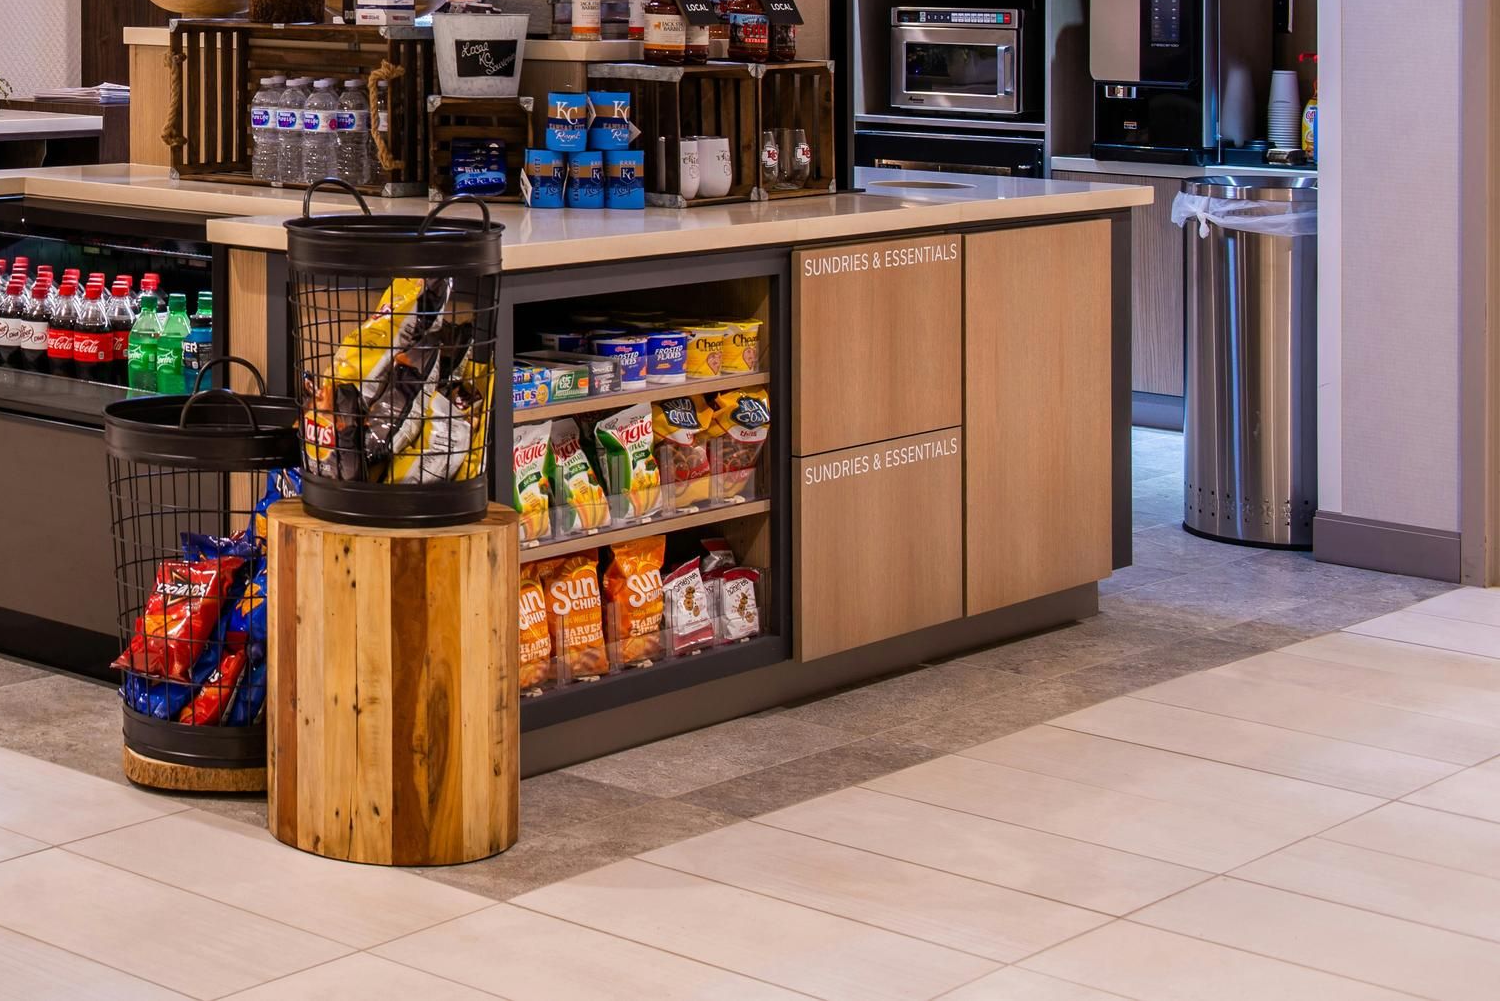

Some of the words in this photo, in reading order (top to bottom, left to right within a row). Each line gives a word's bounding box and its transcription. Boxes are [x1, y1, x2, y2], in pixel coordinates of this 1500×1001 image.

[686, 3, 709, 11] LOCAL
[771, 3, 794, 11] LOCAL
[461, 41, 489, 57] Local
[478, 52, 494, 67] KC
[555, 101, 579, 125] KC
[622, 169, 634, 180] KC
[804, 252, 869, 276] SUNDRIES
[872, 251, 881, 269] &
[885, 243, 957, 268] ESSENTIALS
[654, 345, 683, 356] FROSTED
[805, 455, 869, 485] SUNDRIES
[873, 453, 881, 471] &
[885, 437, 957, 468] ESSENTIALS
[550, 576, 600, 615] Sun
[626, 569, 663, 608] Sun
[571, 596, 601, 610] CHIPS
